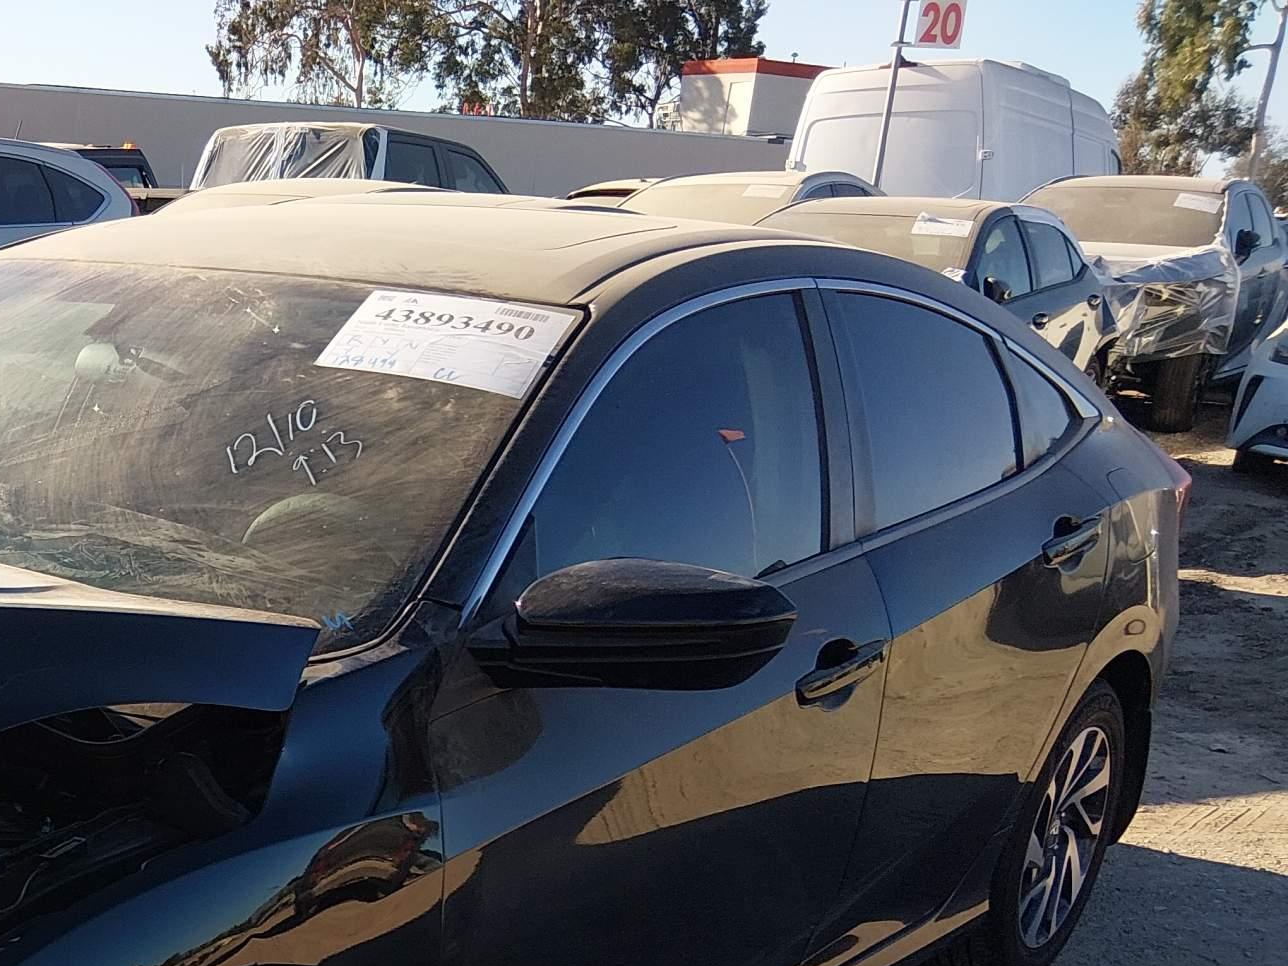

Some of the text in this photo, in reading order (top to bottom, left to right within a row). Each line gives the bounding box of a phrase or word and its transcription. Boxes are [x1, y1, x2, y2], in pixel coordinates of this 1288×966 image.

[919, 2, 962, 45] 20
[375, 307, 535, 340] 43893490
[226, 400, 317, 474] 12/10
